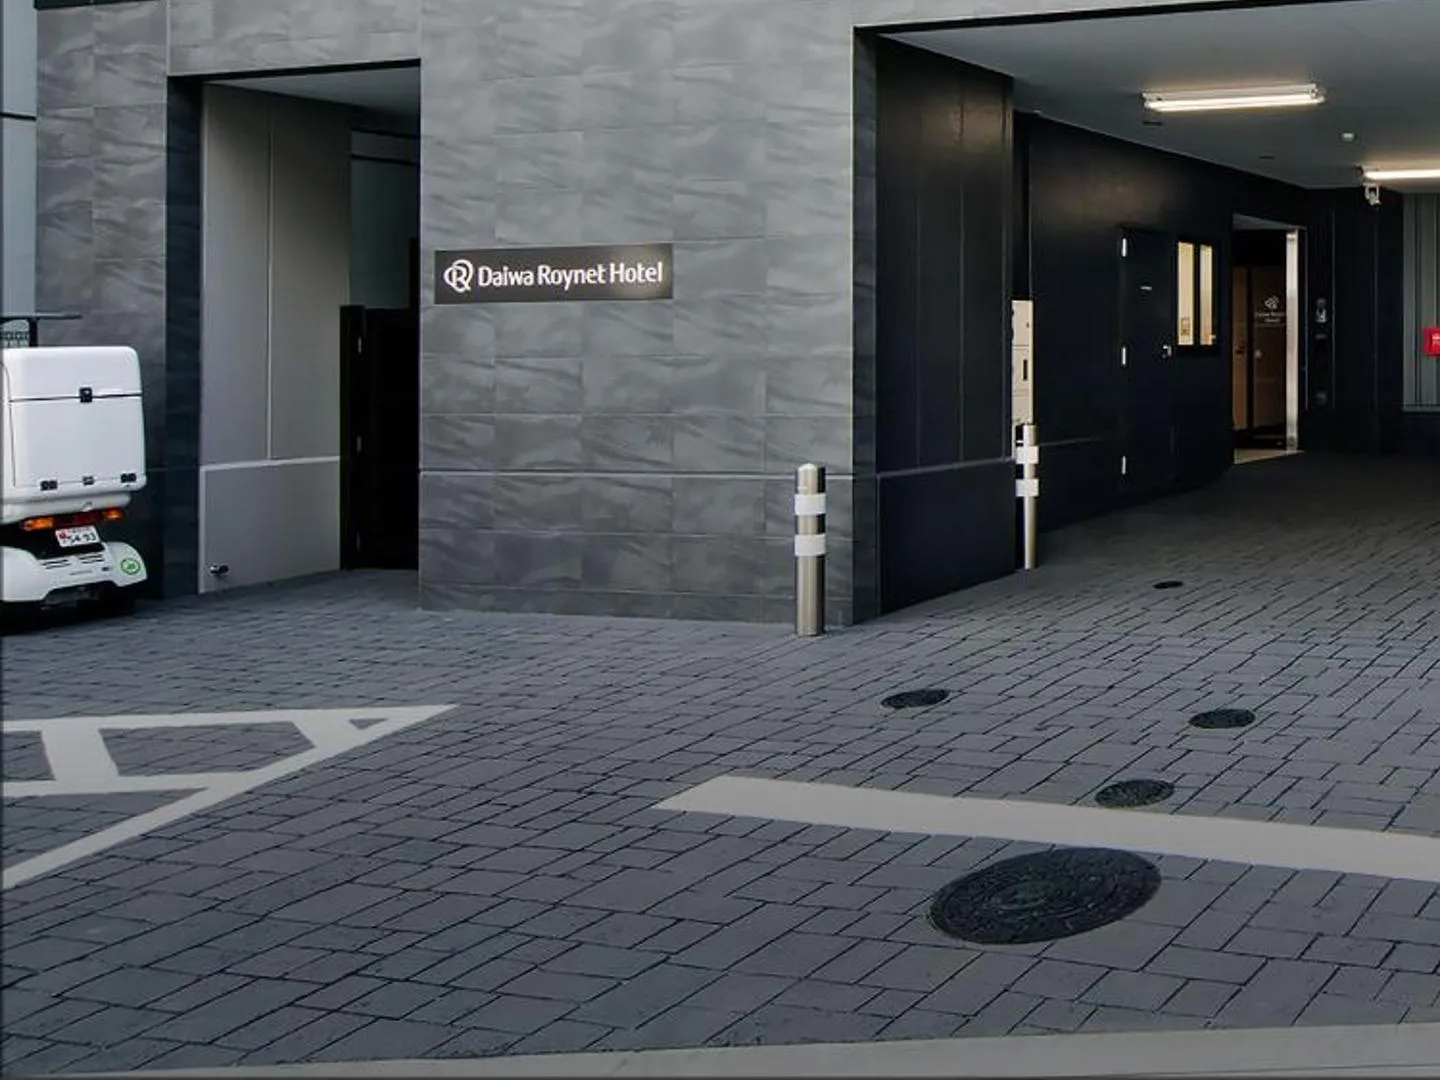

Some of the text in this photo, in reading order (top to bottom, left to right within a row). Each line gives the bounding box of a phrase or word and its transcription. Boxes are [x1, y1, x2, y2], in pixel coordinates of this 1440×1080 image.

[477, 261, 663, 290] Daiwa Roynet Hotel
